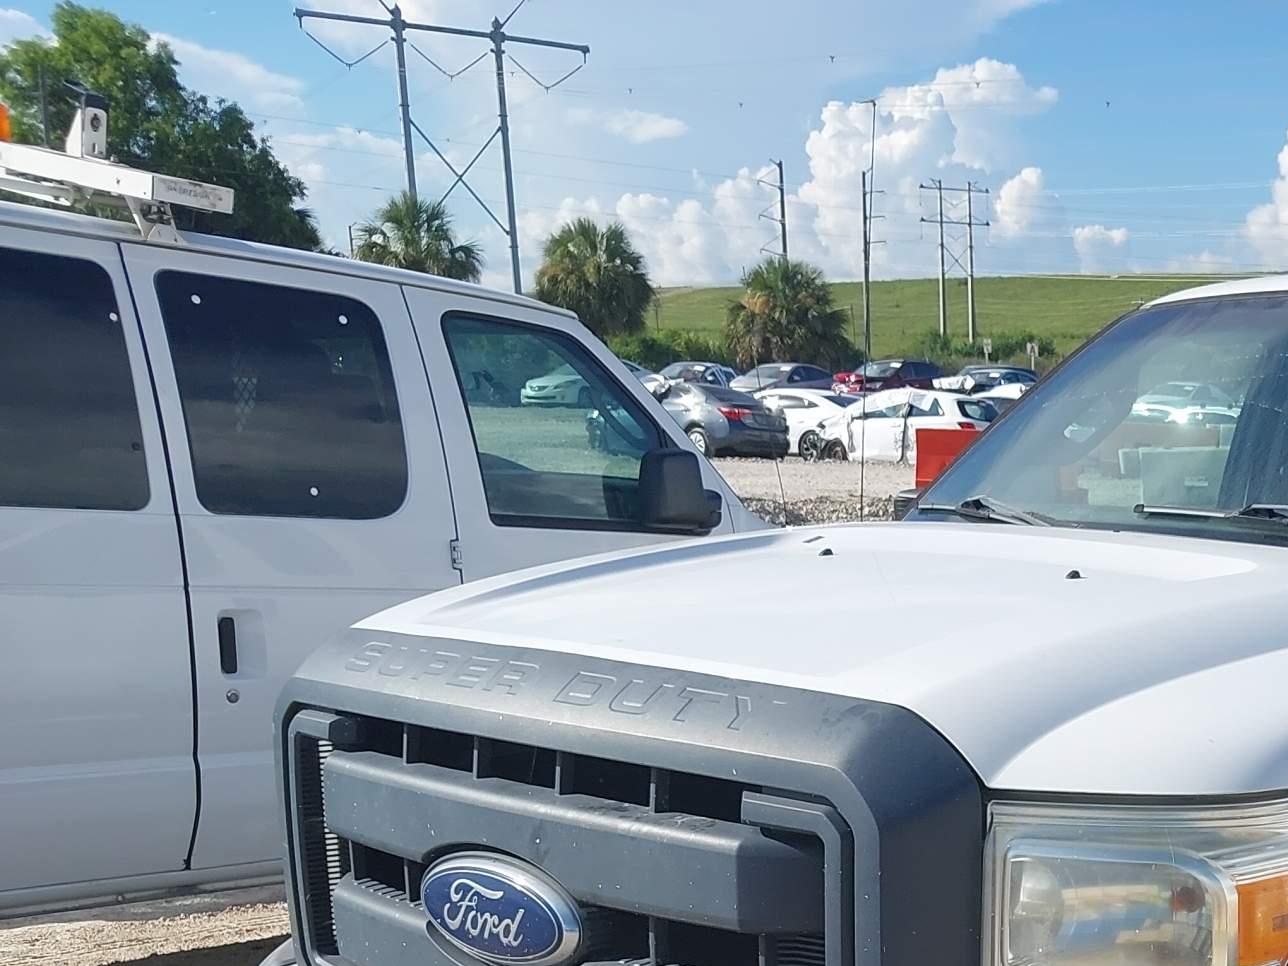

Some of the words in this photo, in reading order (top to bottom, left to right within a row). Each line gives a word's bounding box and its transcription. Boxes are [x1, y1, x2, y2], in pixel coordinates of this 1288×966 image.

[345, 641, 540, 696] SUPER
[552, 671, 787, 731] DUTY
[444, 878, 523, 947] Ford
